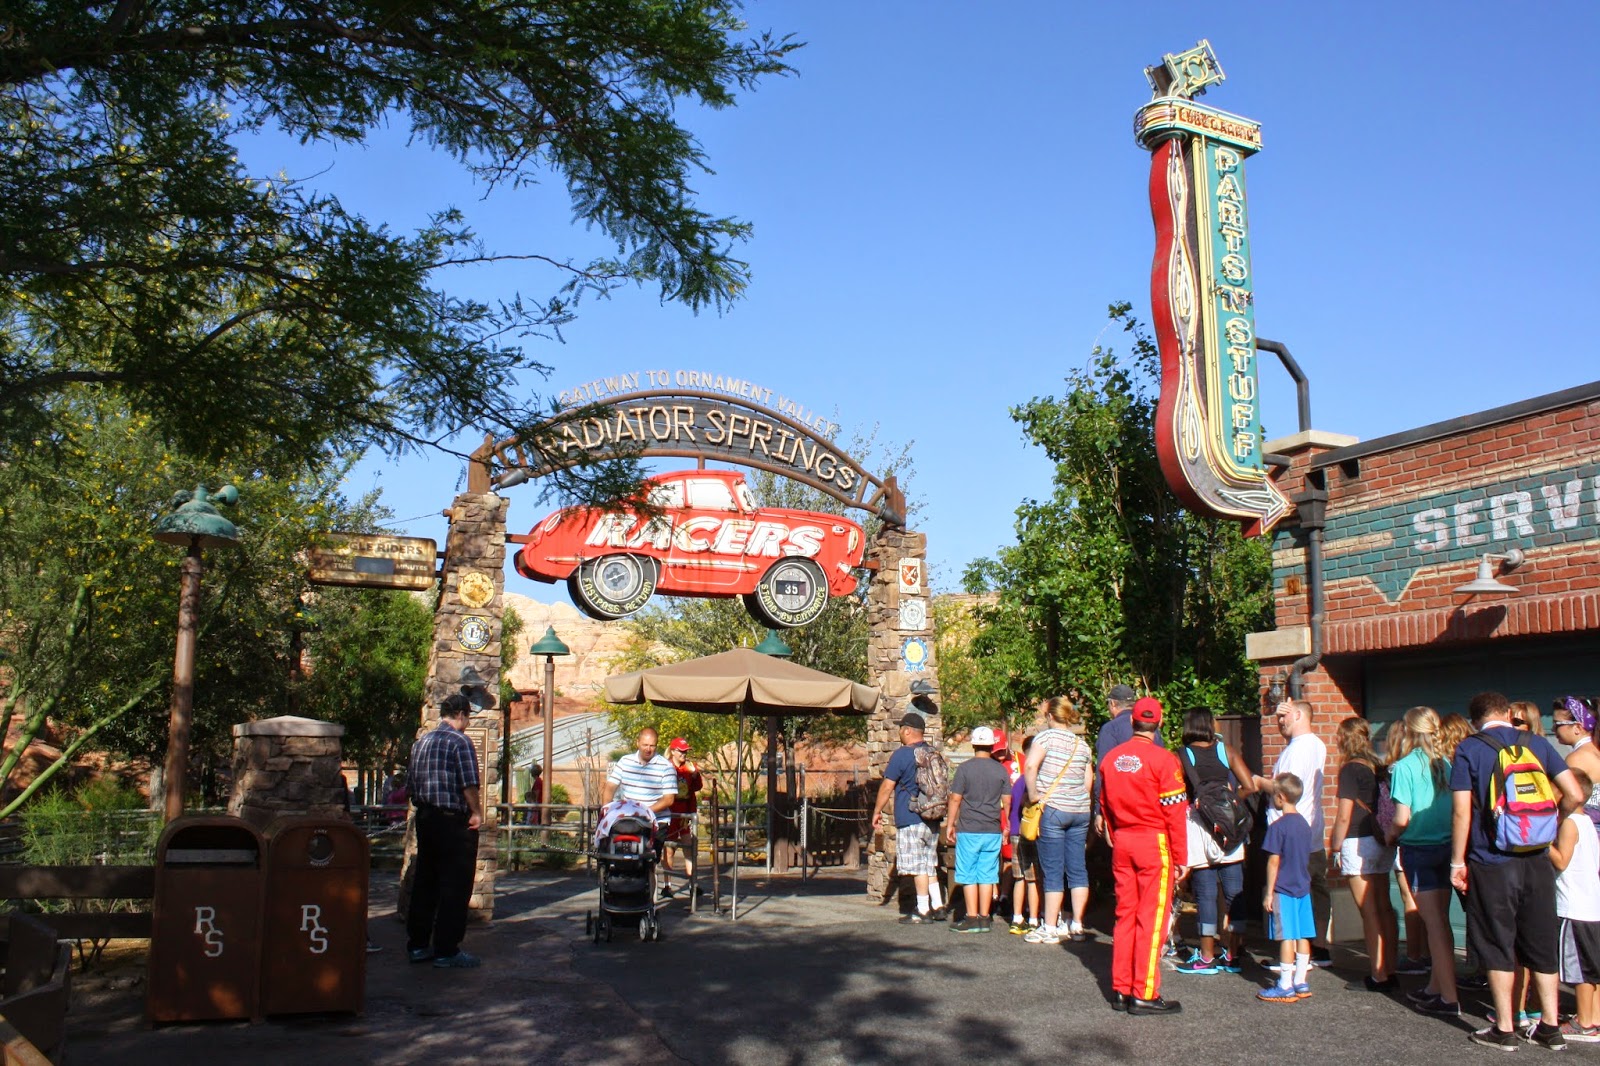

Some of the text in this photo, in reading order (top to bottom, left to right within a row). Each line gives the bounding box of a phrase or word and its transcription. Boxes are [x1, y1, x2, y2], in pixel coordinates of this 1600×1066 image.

[1215, 146, 1248, 280] PARTS
[559, 370, 836, 435] GATEWAY TO ORNAMENT VALLEY
[1225, 317, 1256, 458] STUFF
[706, 409, 855, 490] SPRINGS
[376, 543, 423, 555] RIDERS
[585, 513, 825, 557] RACERS
[396, 563, 429, 571] MINUTES
[785, 585, 798, 595] 35
[796, 586, 826, 621] ENTRANCE
